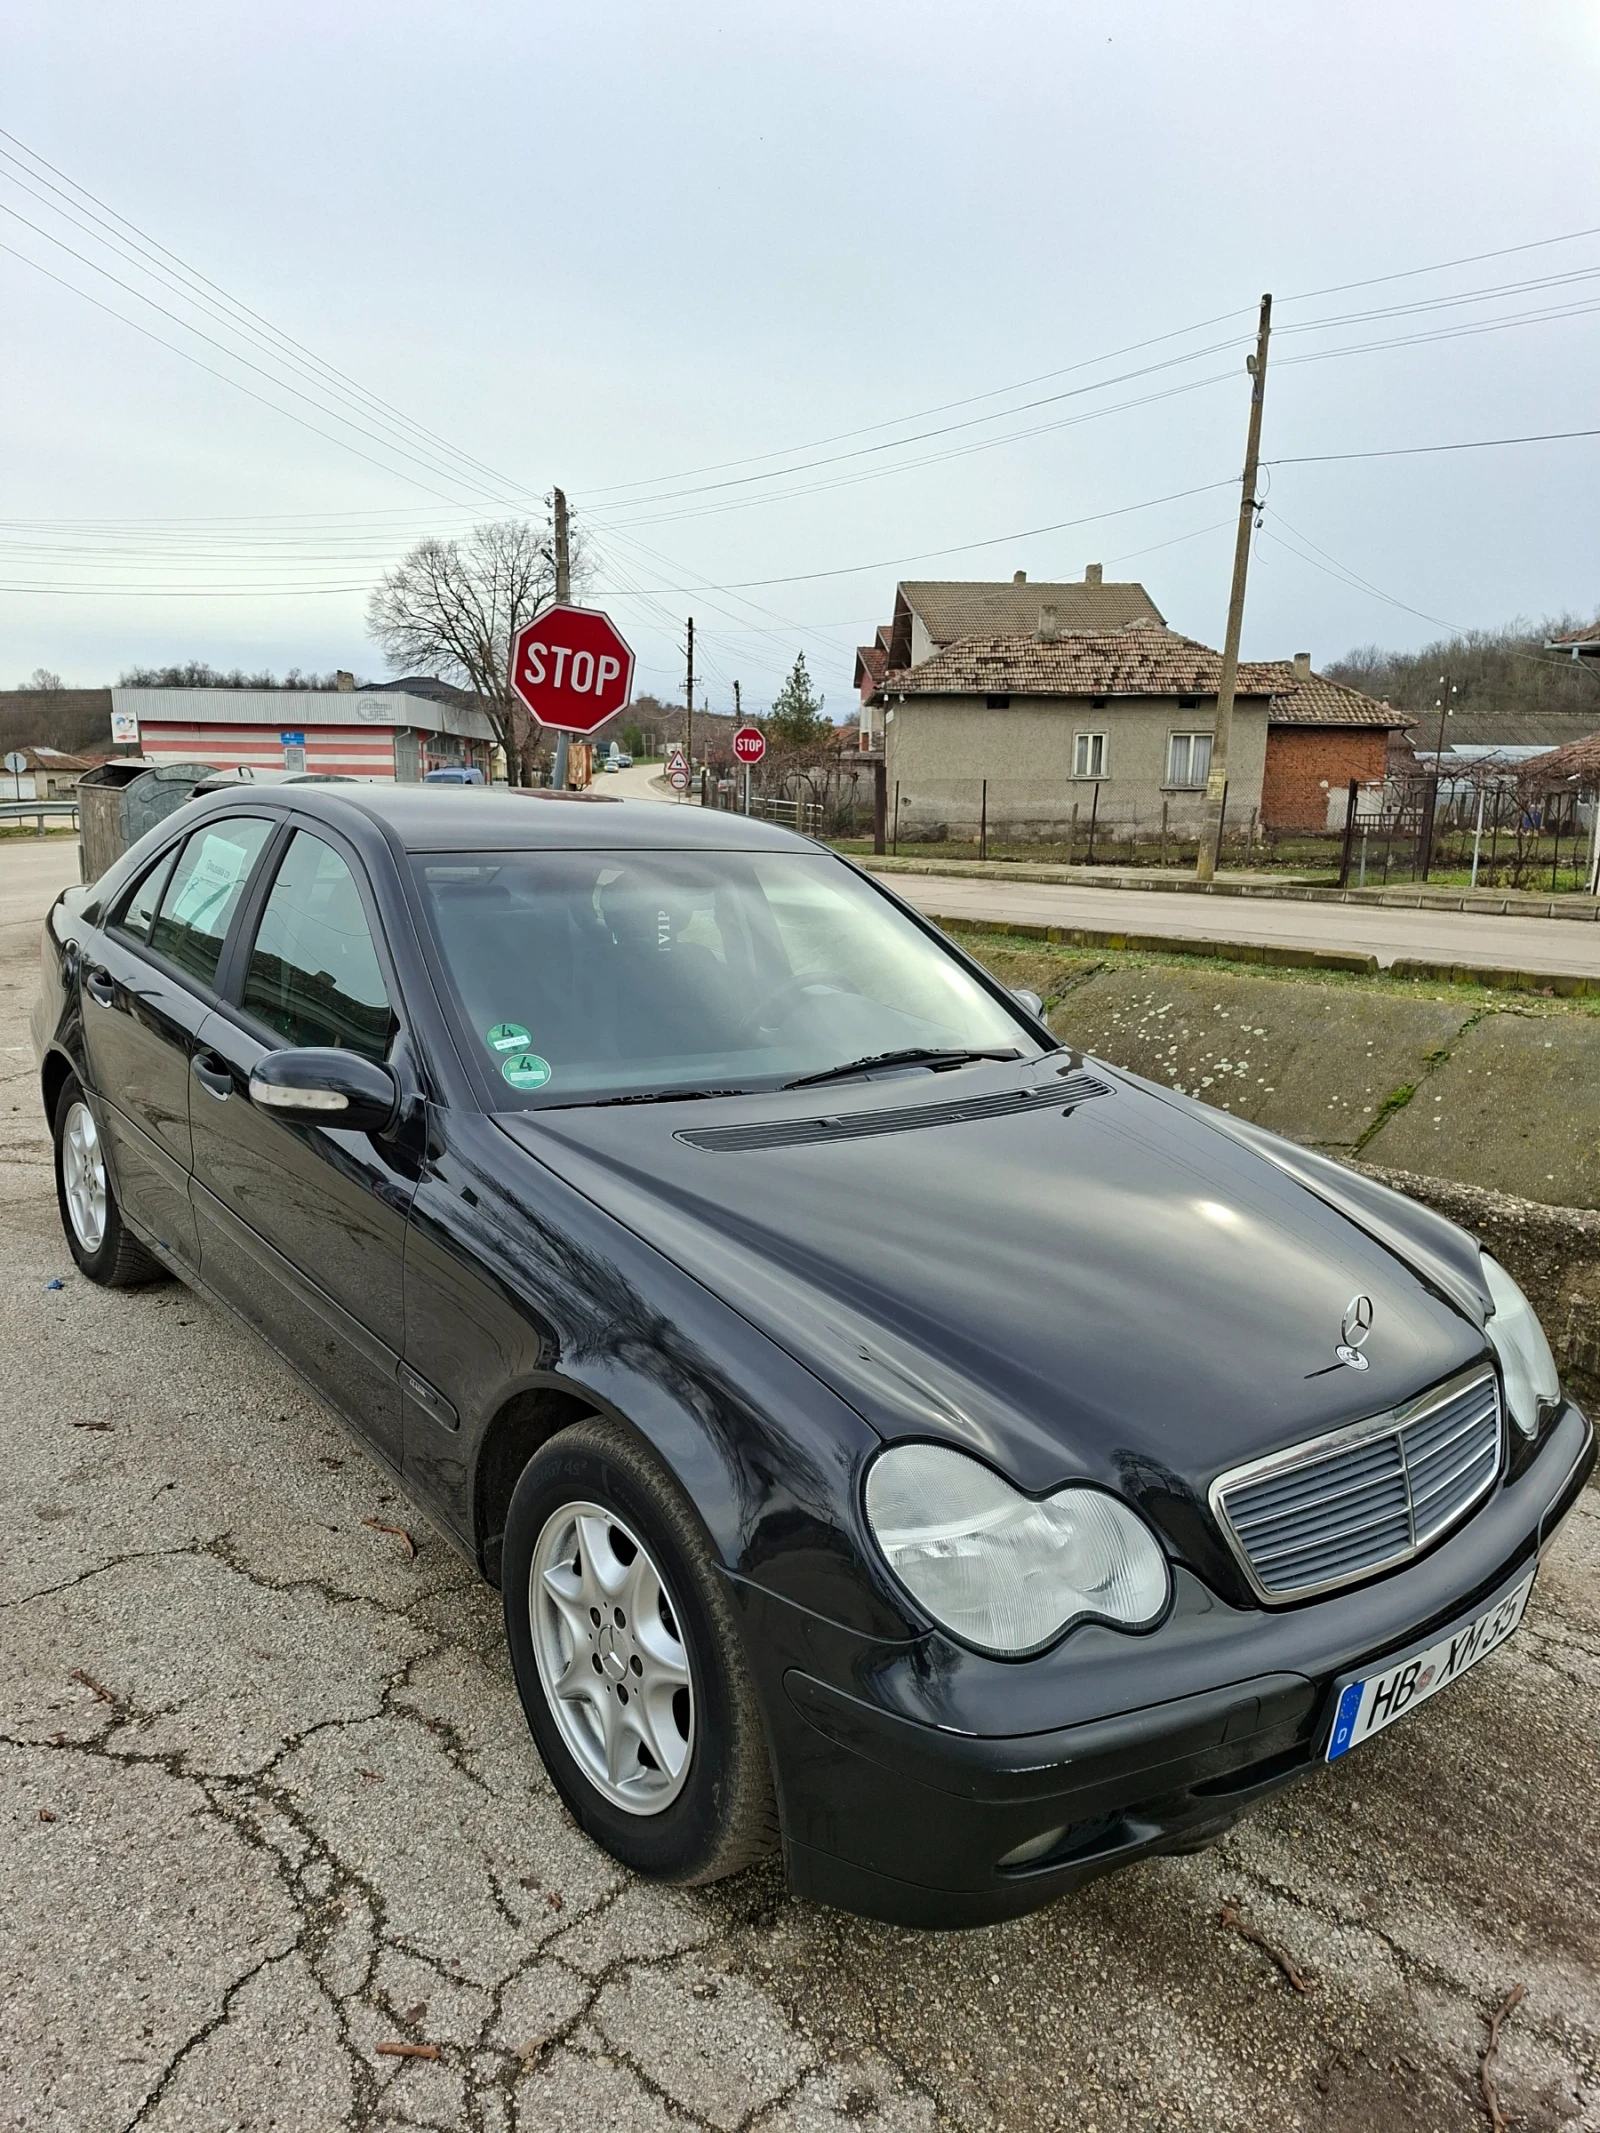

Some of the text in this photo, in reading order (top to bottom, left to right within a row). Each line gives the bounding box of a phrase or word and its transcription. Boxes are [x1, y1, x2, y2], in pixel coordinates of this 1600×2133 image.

[524, 641, 620, 696] STOP
[736, 738, 762, 752] STOP
[657, 910, 671, 945] VIP
[501, 1024, 514, 1037] 4
[519, 1056, 533, 1071] 4
[1366, 1660, 1422, 1730] HB
[1337, 1727, 1348, 1744] D
